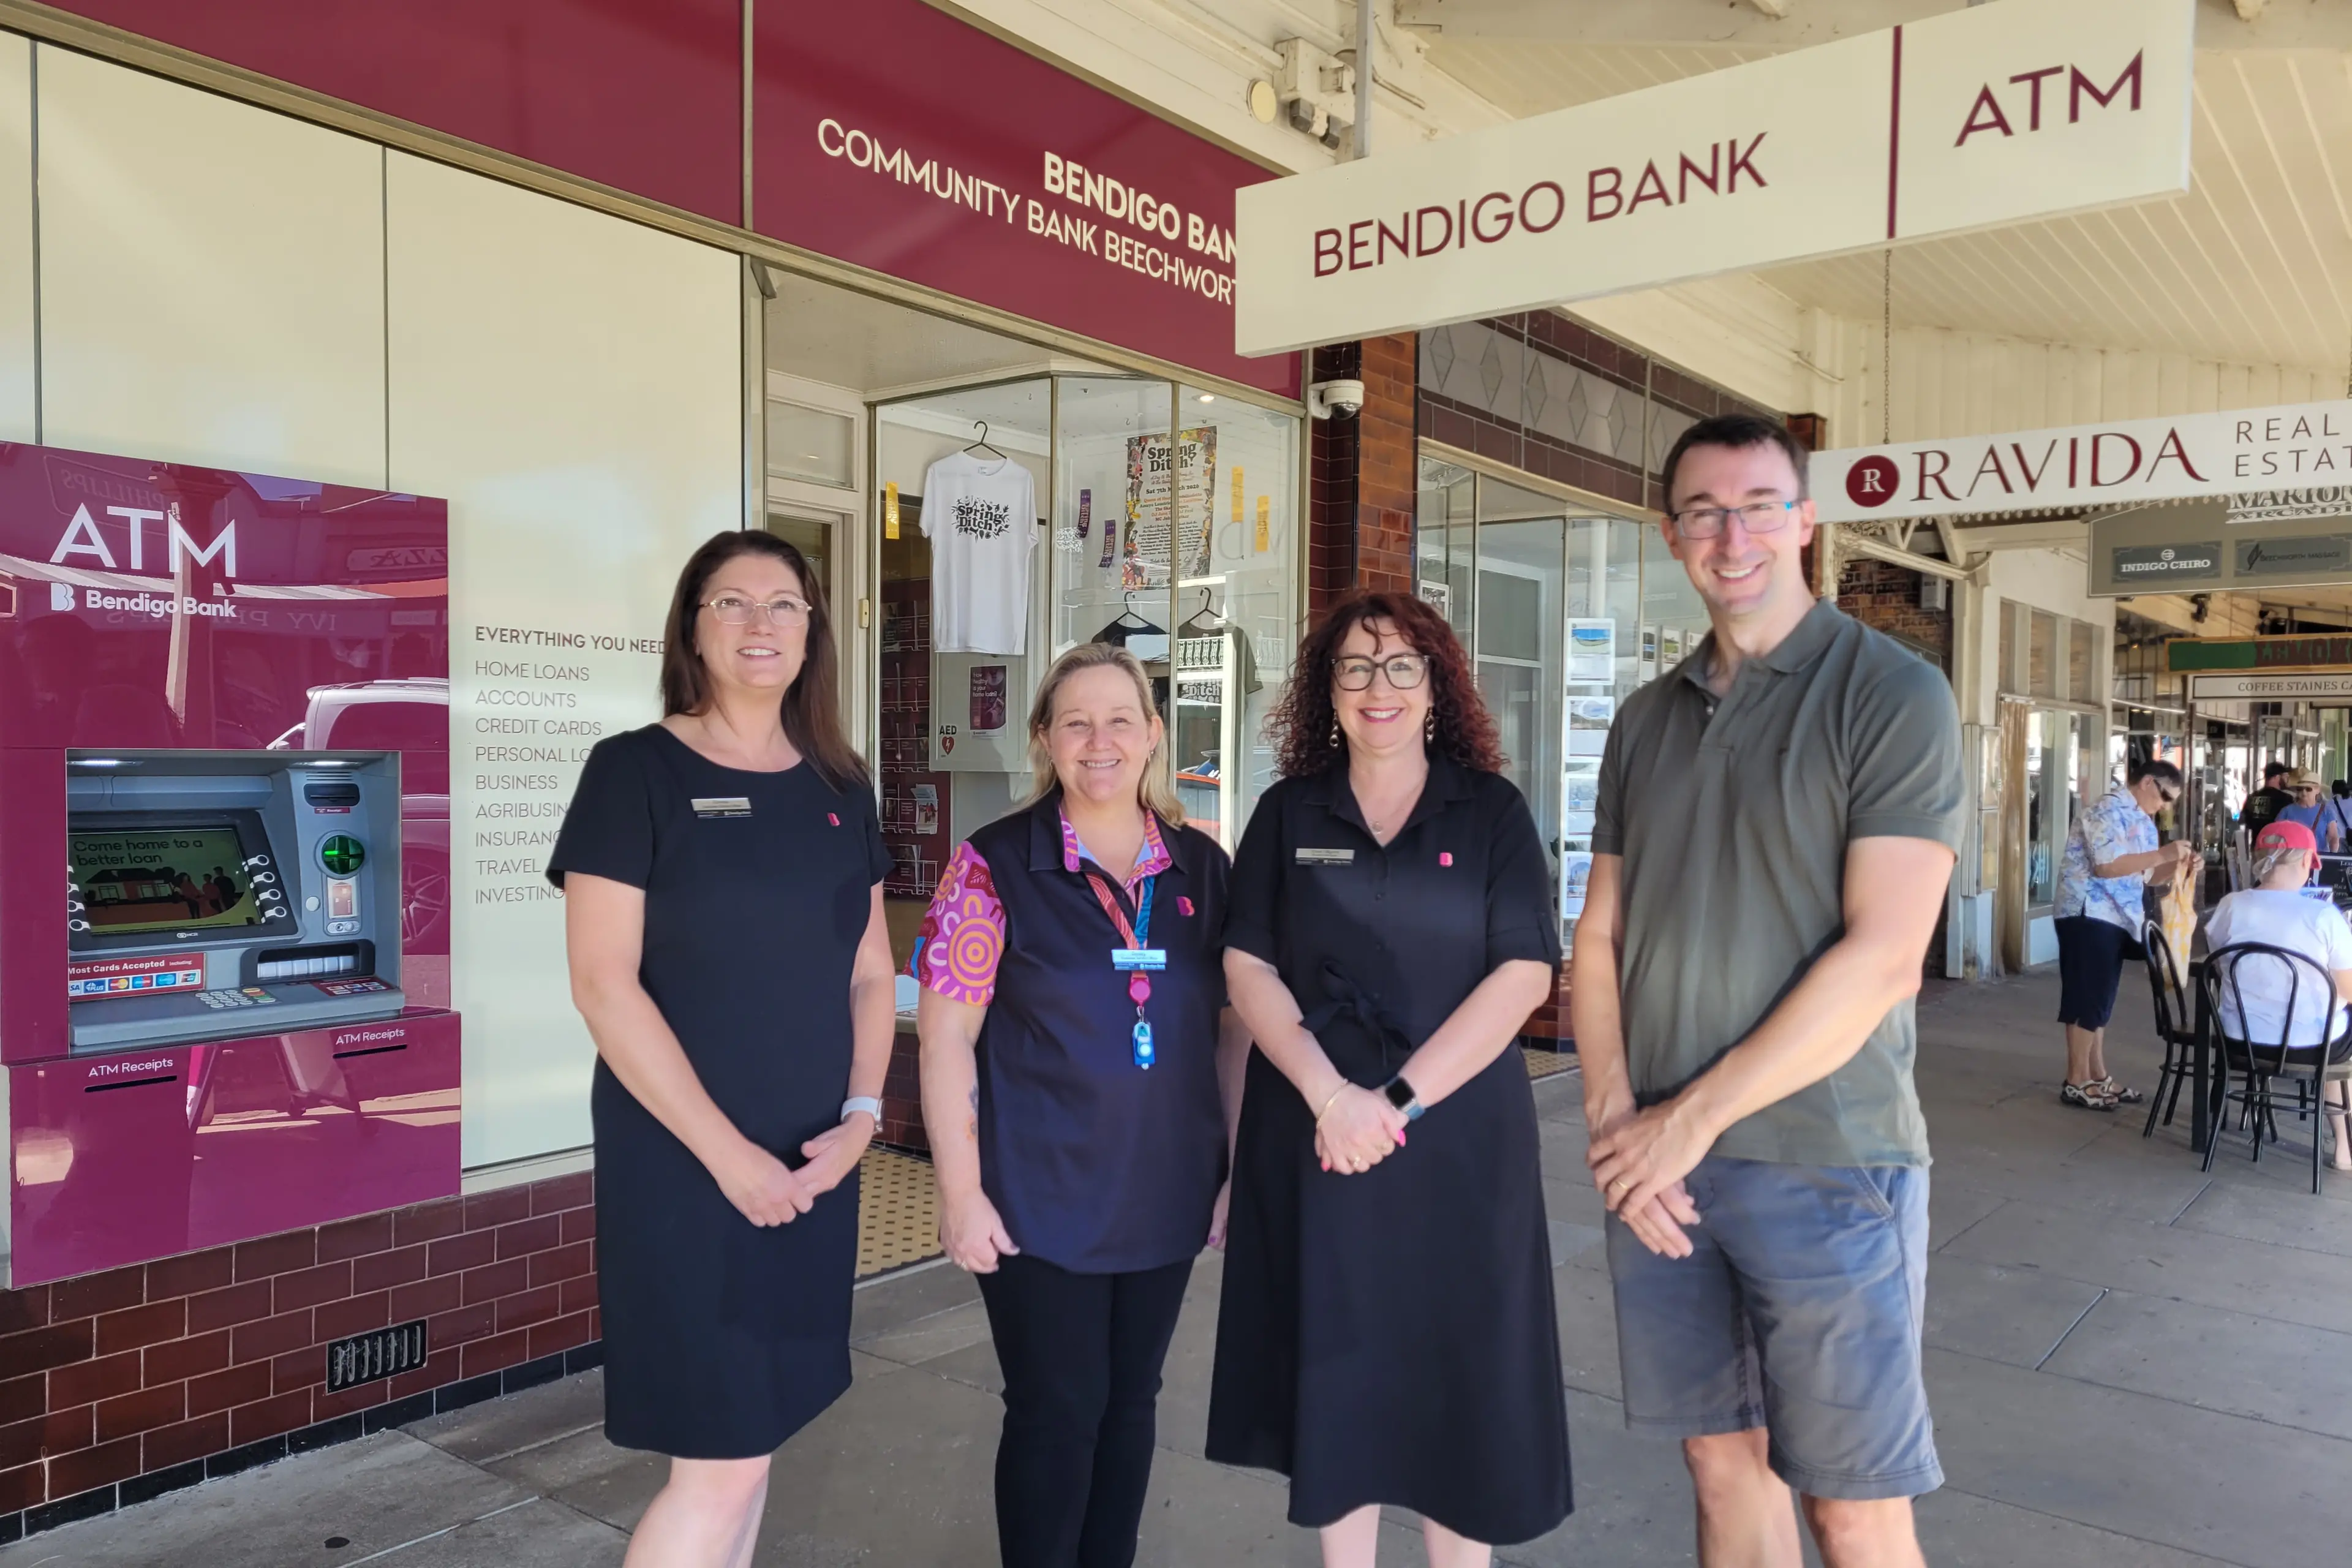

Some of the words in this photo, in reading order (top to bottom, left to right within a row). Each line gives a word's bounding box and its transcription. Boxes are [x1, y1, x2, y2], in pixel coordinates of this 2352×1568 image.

[1953, 47, 2143, 148] ATM
[818, 119, 1020, 224] COMMUNITY
[1028, 199, 1098, 255] BANK
[1105, 229, 1236, 306] BEECHWOR
[1044, 151, 1180, 239] BENDIGO
[1188, 213, 1236, 263] BAN
[1314, 181, 1566, 278] BENDIGO
[1588, 131, 1769, 224] BANK
[2237, 413, 2340, 444] REAL
[1148, 442, 1197, 459] Sprng
[1150, 456, 1194, 472] Dith!
[1909, 427, 2210, 502] RAVIDA
[957, 503, 1003, 525] Spring
[49, 502, 236, 578] ATM
[2121, 561, 2168, 573] INDIGO
[2170, 559, 2211, 570] CHIRO
[86, 590, 178, 618] Bendigo
[183, 597, 238, 617] Bank
[476, 626, 586, 649] EVERYTHING
[591, 635, 625, 652] YOU
[2255, 637, 2352, 666] LEMON
[475, 660, 530, 678] HOME
[535, 663, 590, 681] LOANS
[2237, 682, 2283, 692] COFFEE
[2286, 680, 2338, 692] STAINES
[475, 689, 576, 708] ACCOUNTS
[475, 718, 540, 734] CREDIT
[544, 720, 602, 736] CARDS
[939, 725, 957, 735] AED
[475, 746, 568, 763] PERSONAL
[572, 748, 592, 763] LO
[475, 774, 558, 790] BUSINESS
[475, 802, 568, 819] AGRIBUSIN
[74, 840, 123, 853] Come
[126, 839, 169, 850] home
[173, 839, 190, 849] to
[194, 840, 203, 848] a
[475, 830, 562, 848] INSURANC
[76, 854, 124, 866] better
[130, 853, 162, 864] loan
[475, 858, 541, 876] TRAVEL
[475, 886, 565, 904] INVESTING
[69, 965, 91, 974] Most
[93, 964, 120, 973] Cards
[122, 960, 165, 971] Accepted
[336, 1033, 360, 1045] ATM
[363, 1028, 405, 1042] Receipts
[88, 1063, 118, 1077] ATM
[121, 1058, 173, 1073] Receipts
